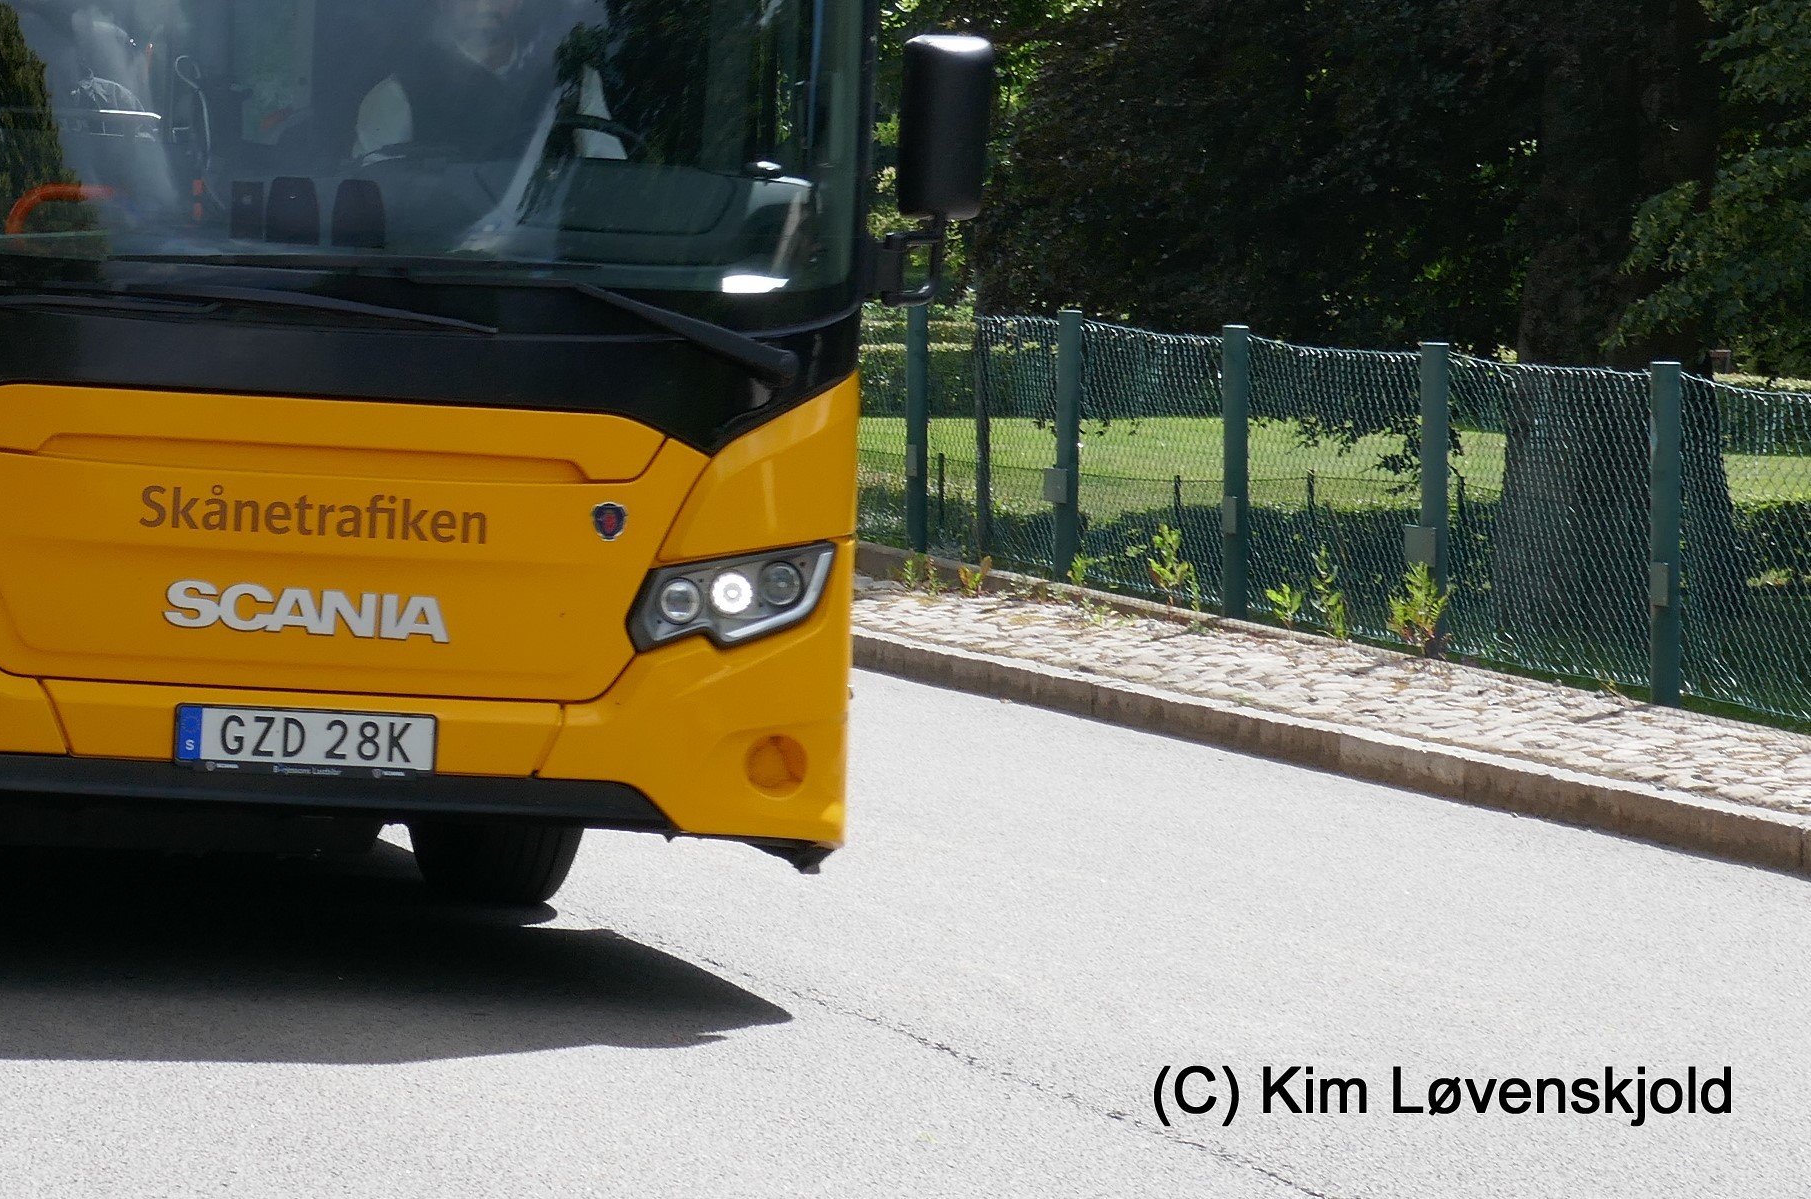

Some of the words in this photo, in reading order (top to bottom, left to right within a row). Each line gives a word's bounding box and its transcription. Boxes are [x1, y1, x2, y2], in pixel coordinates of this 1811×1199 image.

[139, 484, 488, 544] Skånetrafiken
[163, 579, 450, 643] SCANIA
[185, 740, 195, 751] S
[219, 714, 307, 758] GZD
[324, 718, 413, 763] 28K
